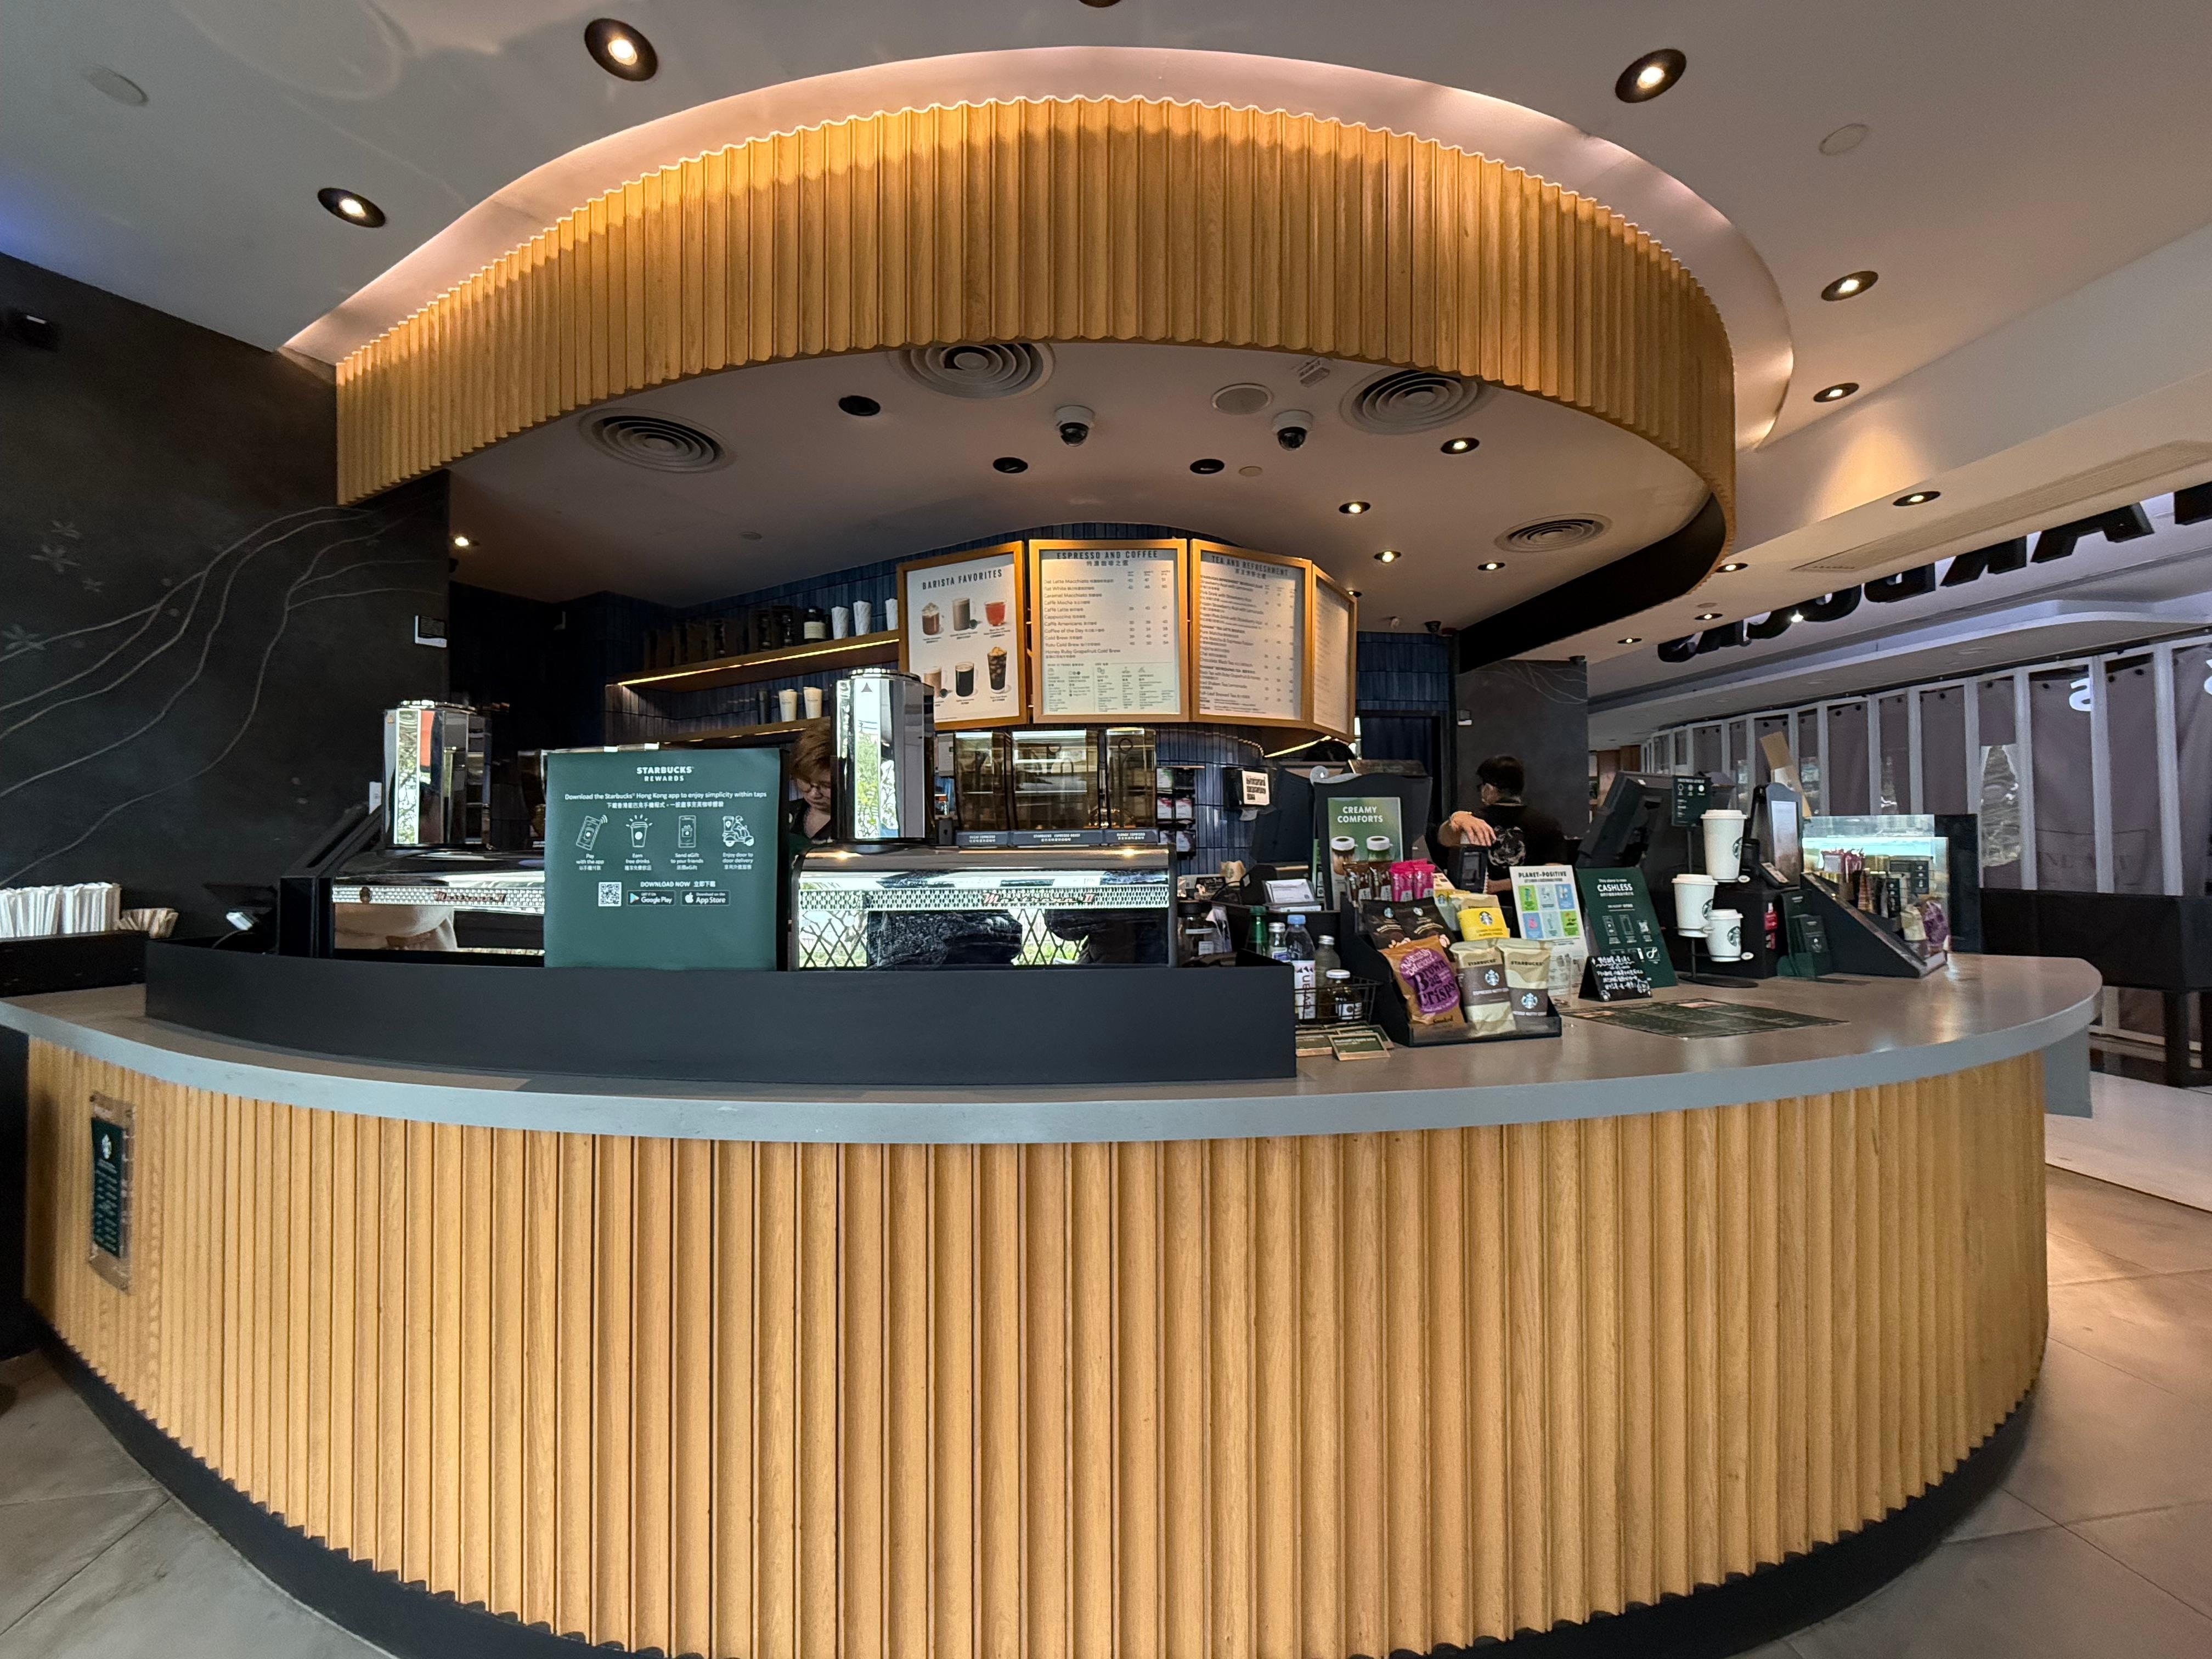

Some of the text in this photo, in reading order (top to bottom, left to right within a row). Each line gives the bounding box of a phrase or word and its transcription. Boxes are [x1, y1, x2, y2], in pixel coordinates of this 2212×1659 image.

[1212, 555, 1223, 564] TEA
[1227, 558, 1239, 567] AND
[922, 569, 1002, 590] BARISTA FAVORITES
[1597, 883, 1633, 892] CASHLESS
